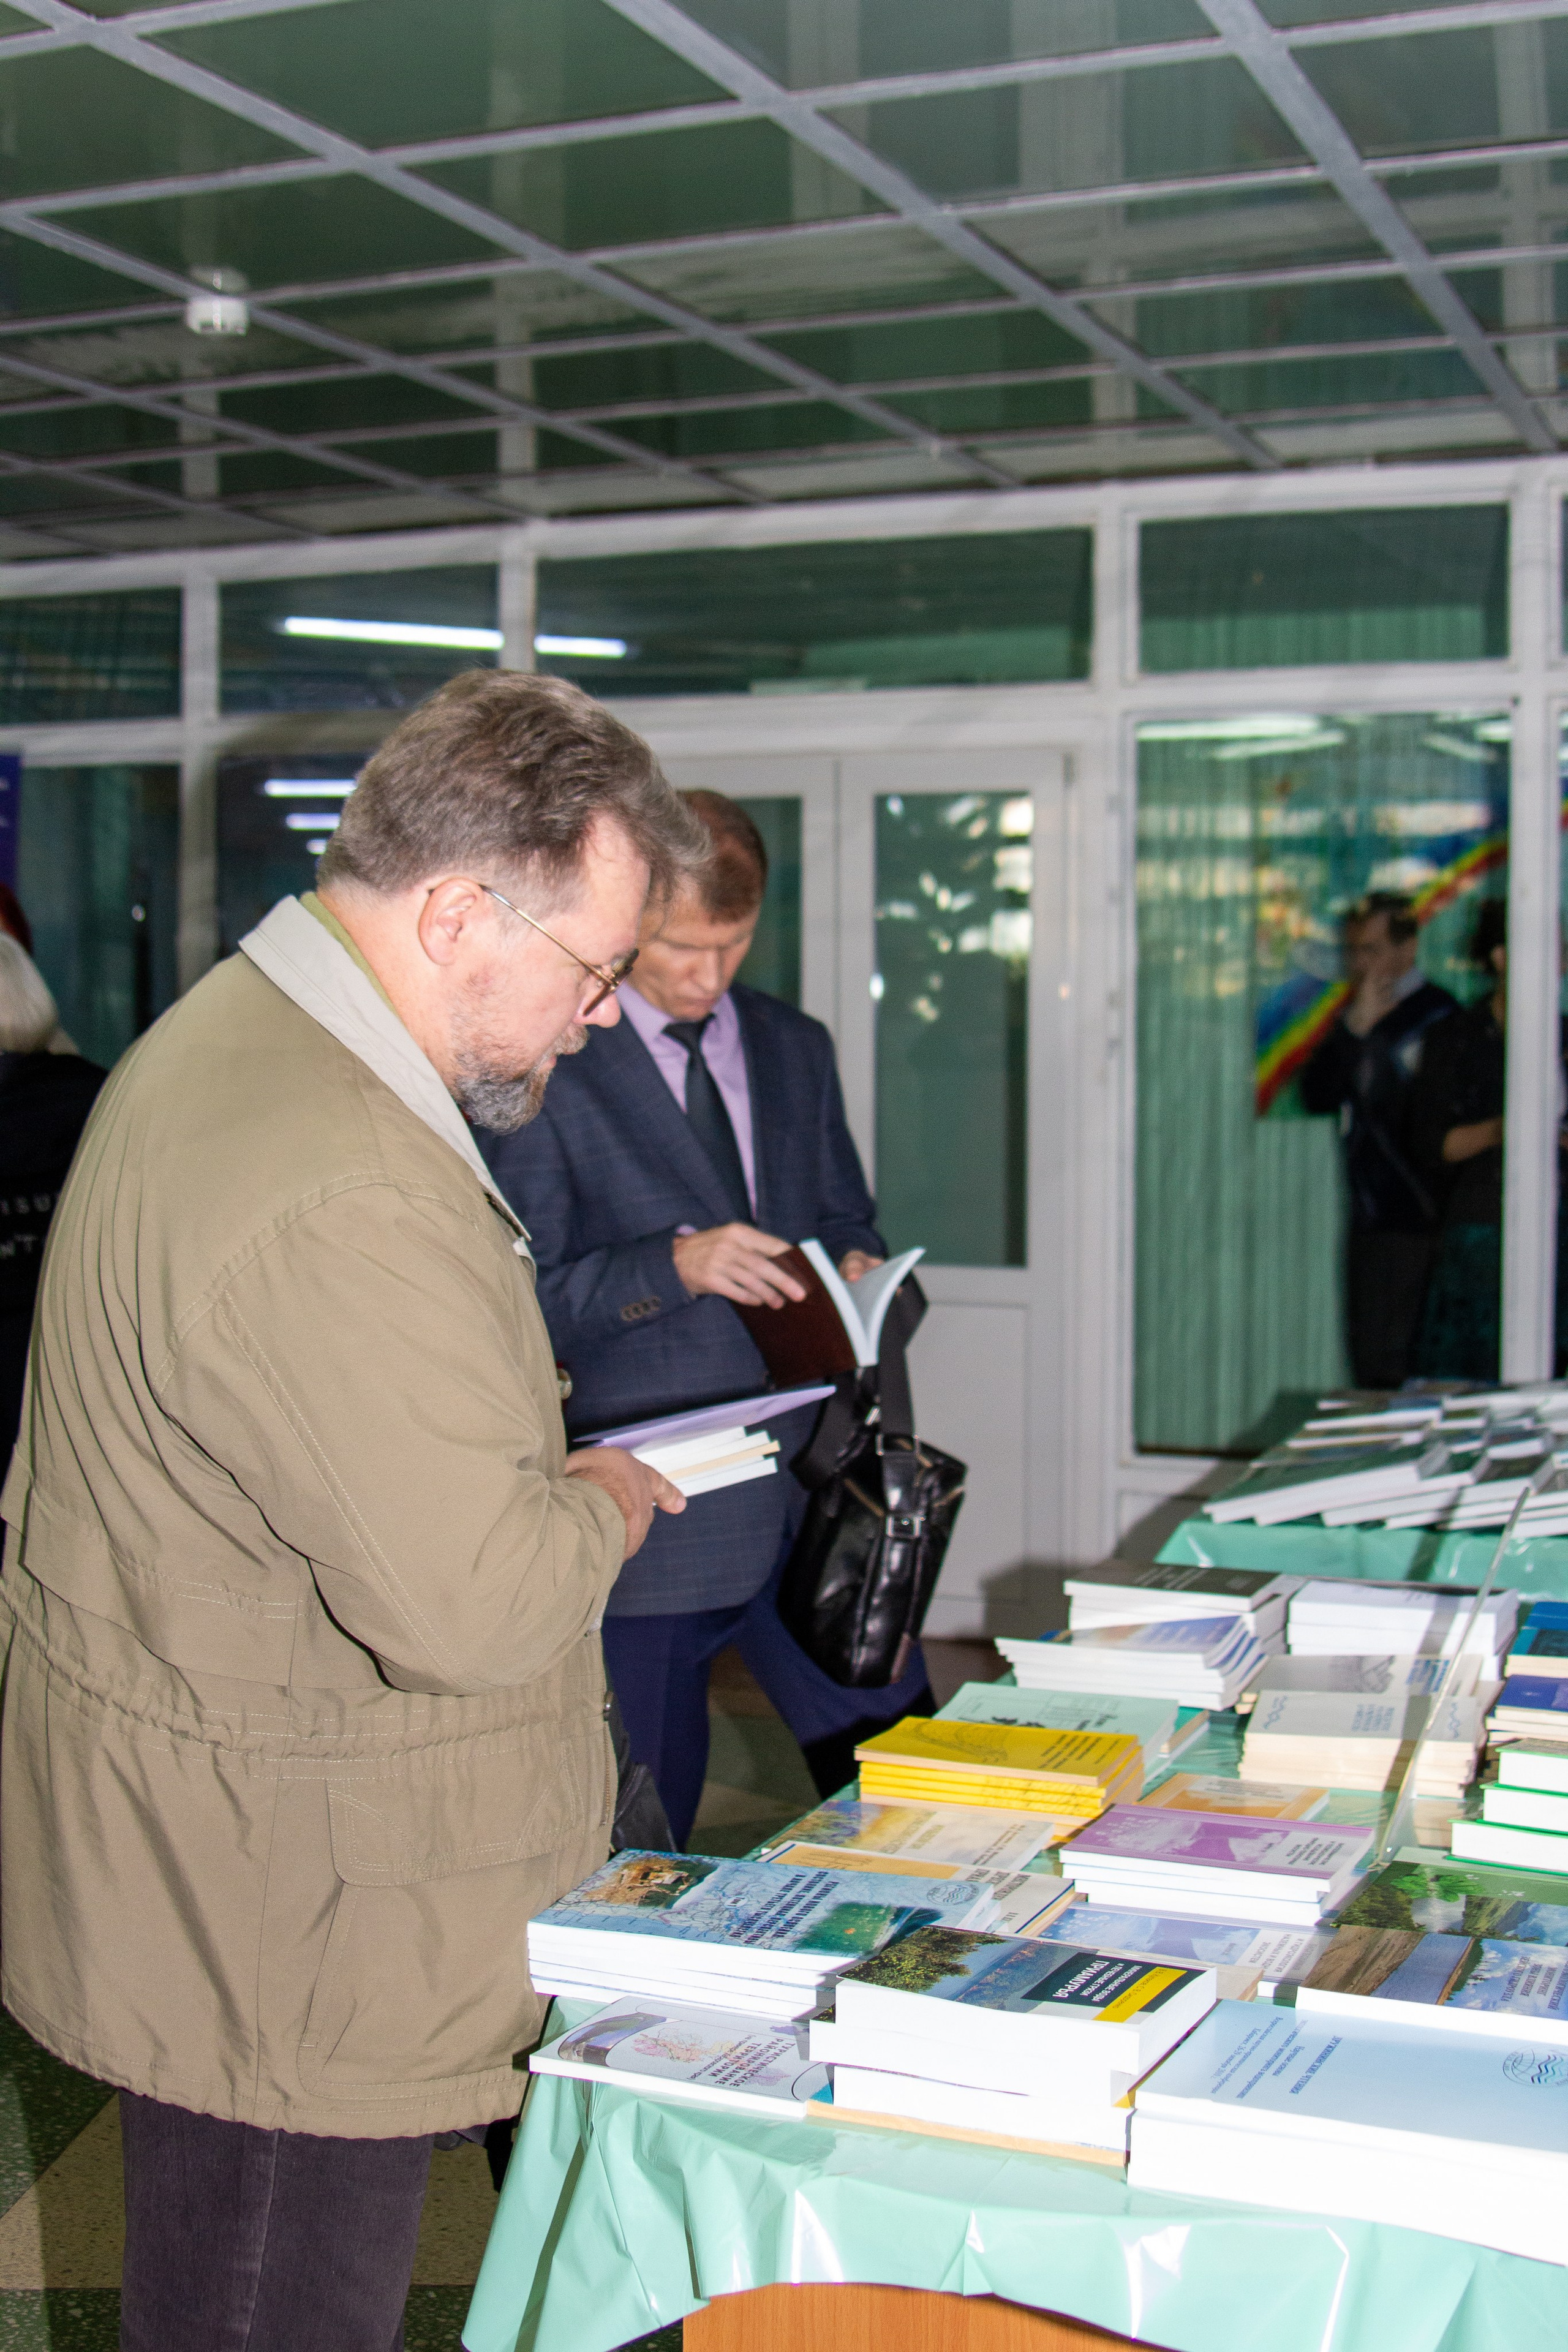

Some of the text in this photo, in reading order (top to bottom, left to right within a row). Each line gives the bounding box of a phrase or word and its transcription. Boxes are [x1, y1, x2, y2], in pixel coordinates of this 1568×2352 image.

[1052, 1960, 1110, 1999] ПРИАМУРЬЯ
[1079, 1983, 1101, 1996] ГРЯЗИ
[1091, 1966, 1142, 2002] МИНЕРАЛЬНЫЕ ВОДЫ
[1095, 1966, 1123, 1984] ЛЕЧЕБНЫЕ
[708, 2043, 762, 2077] ТЕРРИТОРИИ
[715, 2038, 784, 2084] РАЙОНИРОВАНИЕ
[729, 2043, 796, 2087] ТУРИСТИЧЕСКОЕ
[1289, 2035, 1343, 2095] ДРУЖИНИНСКИЕ ЧТЕНИЯ
